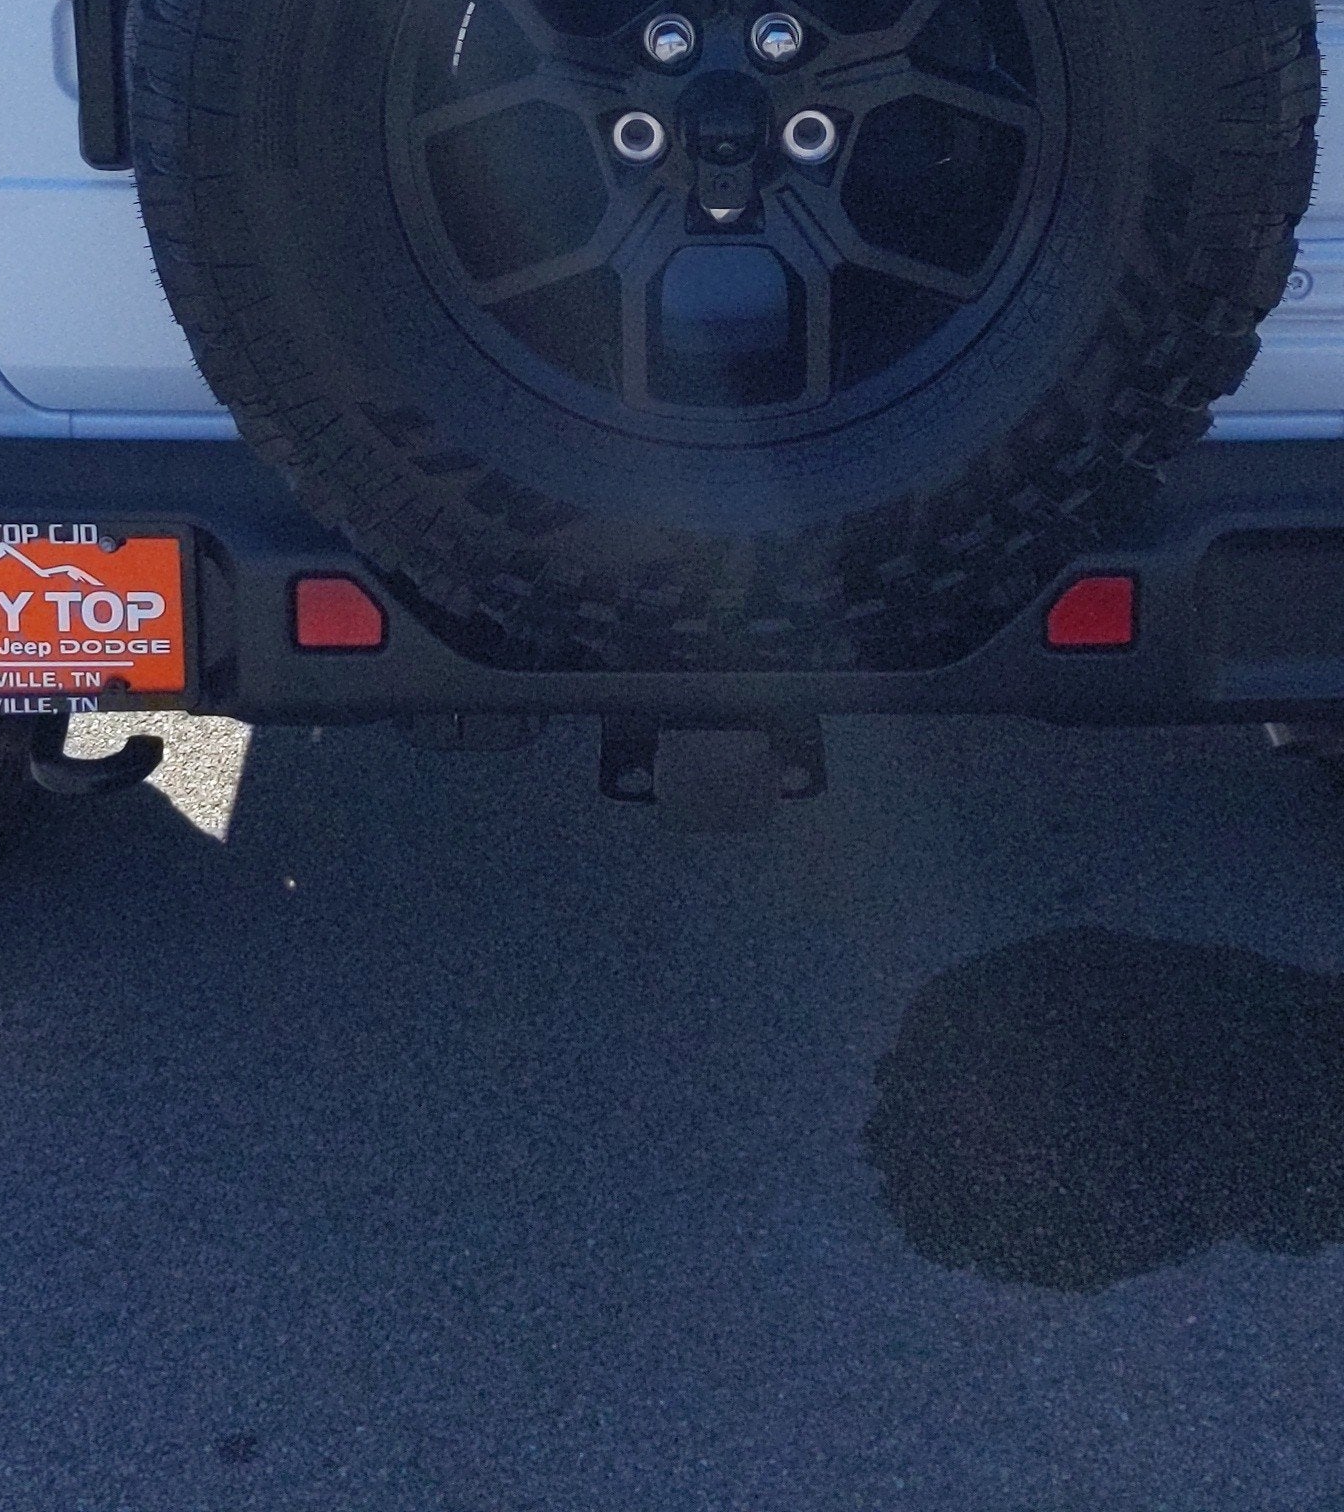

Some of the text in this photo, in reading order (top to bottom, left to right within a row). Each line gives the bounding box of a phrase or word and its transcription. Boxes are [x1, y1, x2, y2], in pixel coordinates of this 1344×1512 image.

[49, 524, 98, 544] CJD
[44, 590, 166, 632] TOP
[60, 639, 171, 655] DODGE
[71, 671, 101, 687] TN
[67, 696, 99, 713] TN
